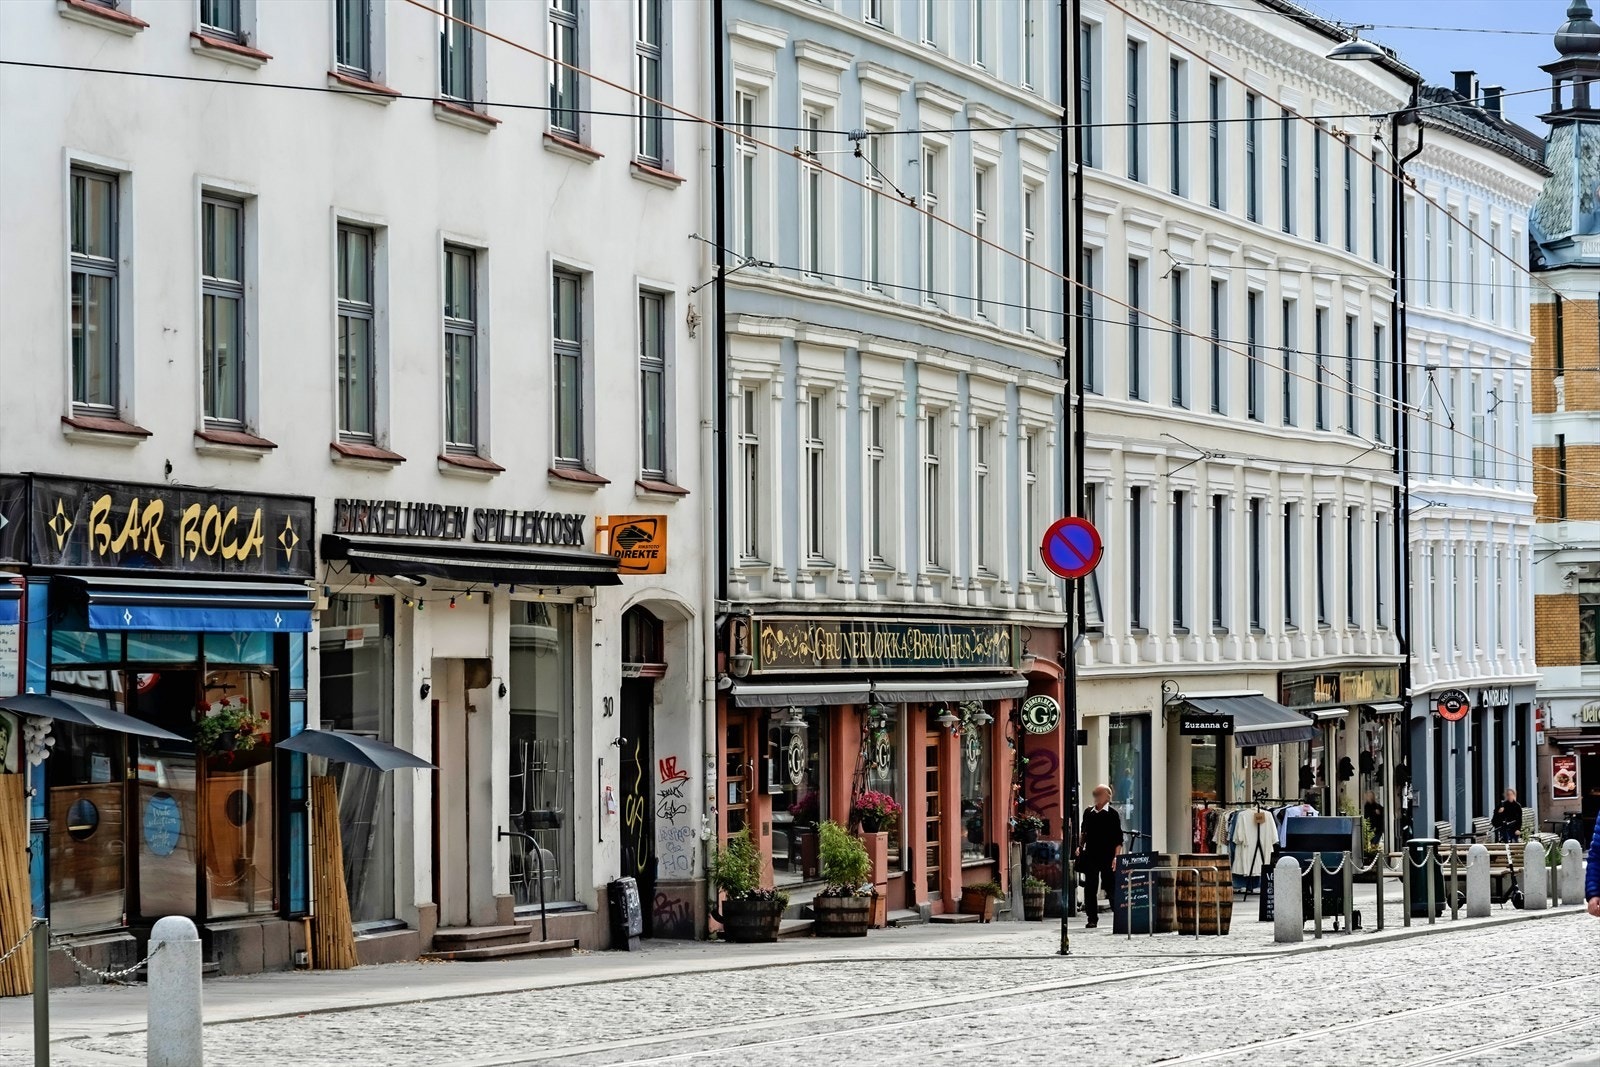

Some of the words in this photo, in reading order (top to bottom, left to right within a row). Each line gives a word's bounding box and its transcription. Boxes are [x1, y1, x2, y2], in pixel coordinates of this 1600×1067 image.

[89, 494, 165, 559] BAR
[180, 503, 264, 561] BOCA
[333, 498, 469, 539] BIRKELUNDEN
[472, 507, 586, 546] SPILLEKIOSK
[614, 549, 659, 559] DIREKTE
[913, 628, 971, 660] BRYGGHUS
[602, 696, 614, 718] 30
[1030, 706, 1049, 725] G
[1184, 721, 1221, 729] Zuzanna
[1222, 721, 1229, 729] G
[792, 748, 801, 772] G
[879, 743, 888, 767] G
